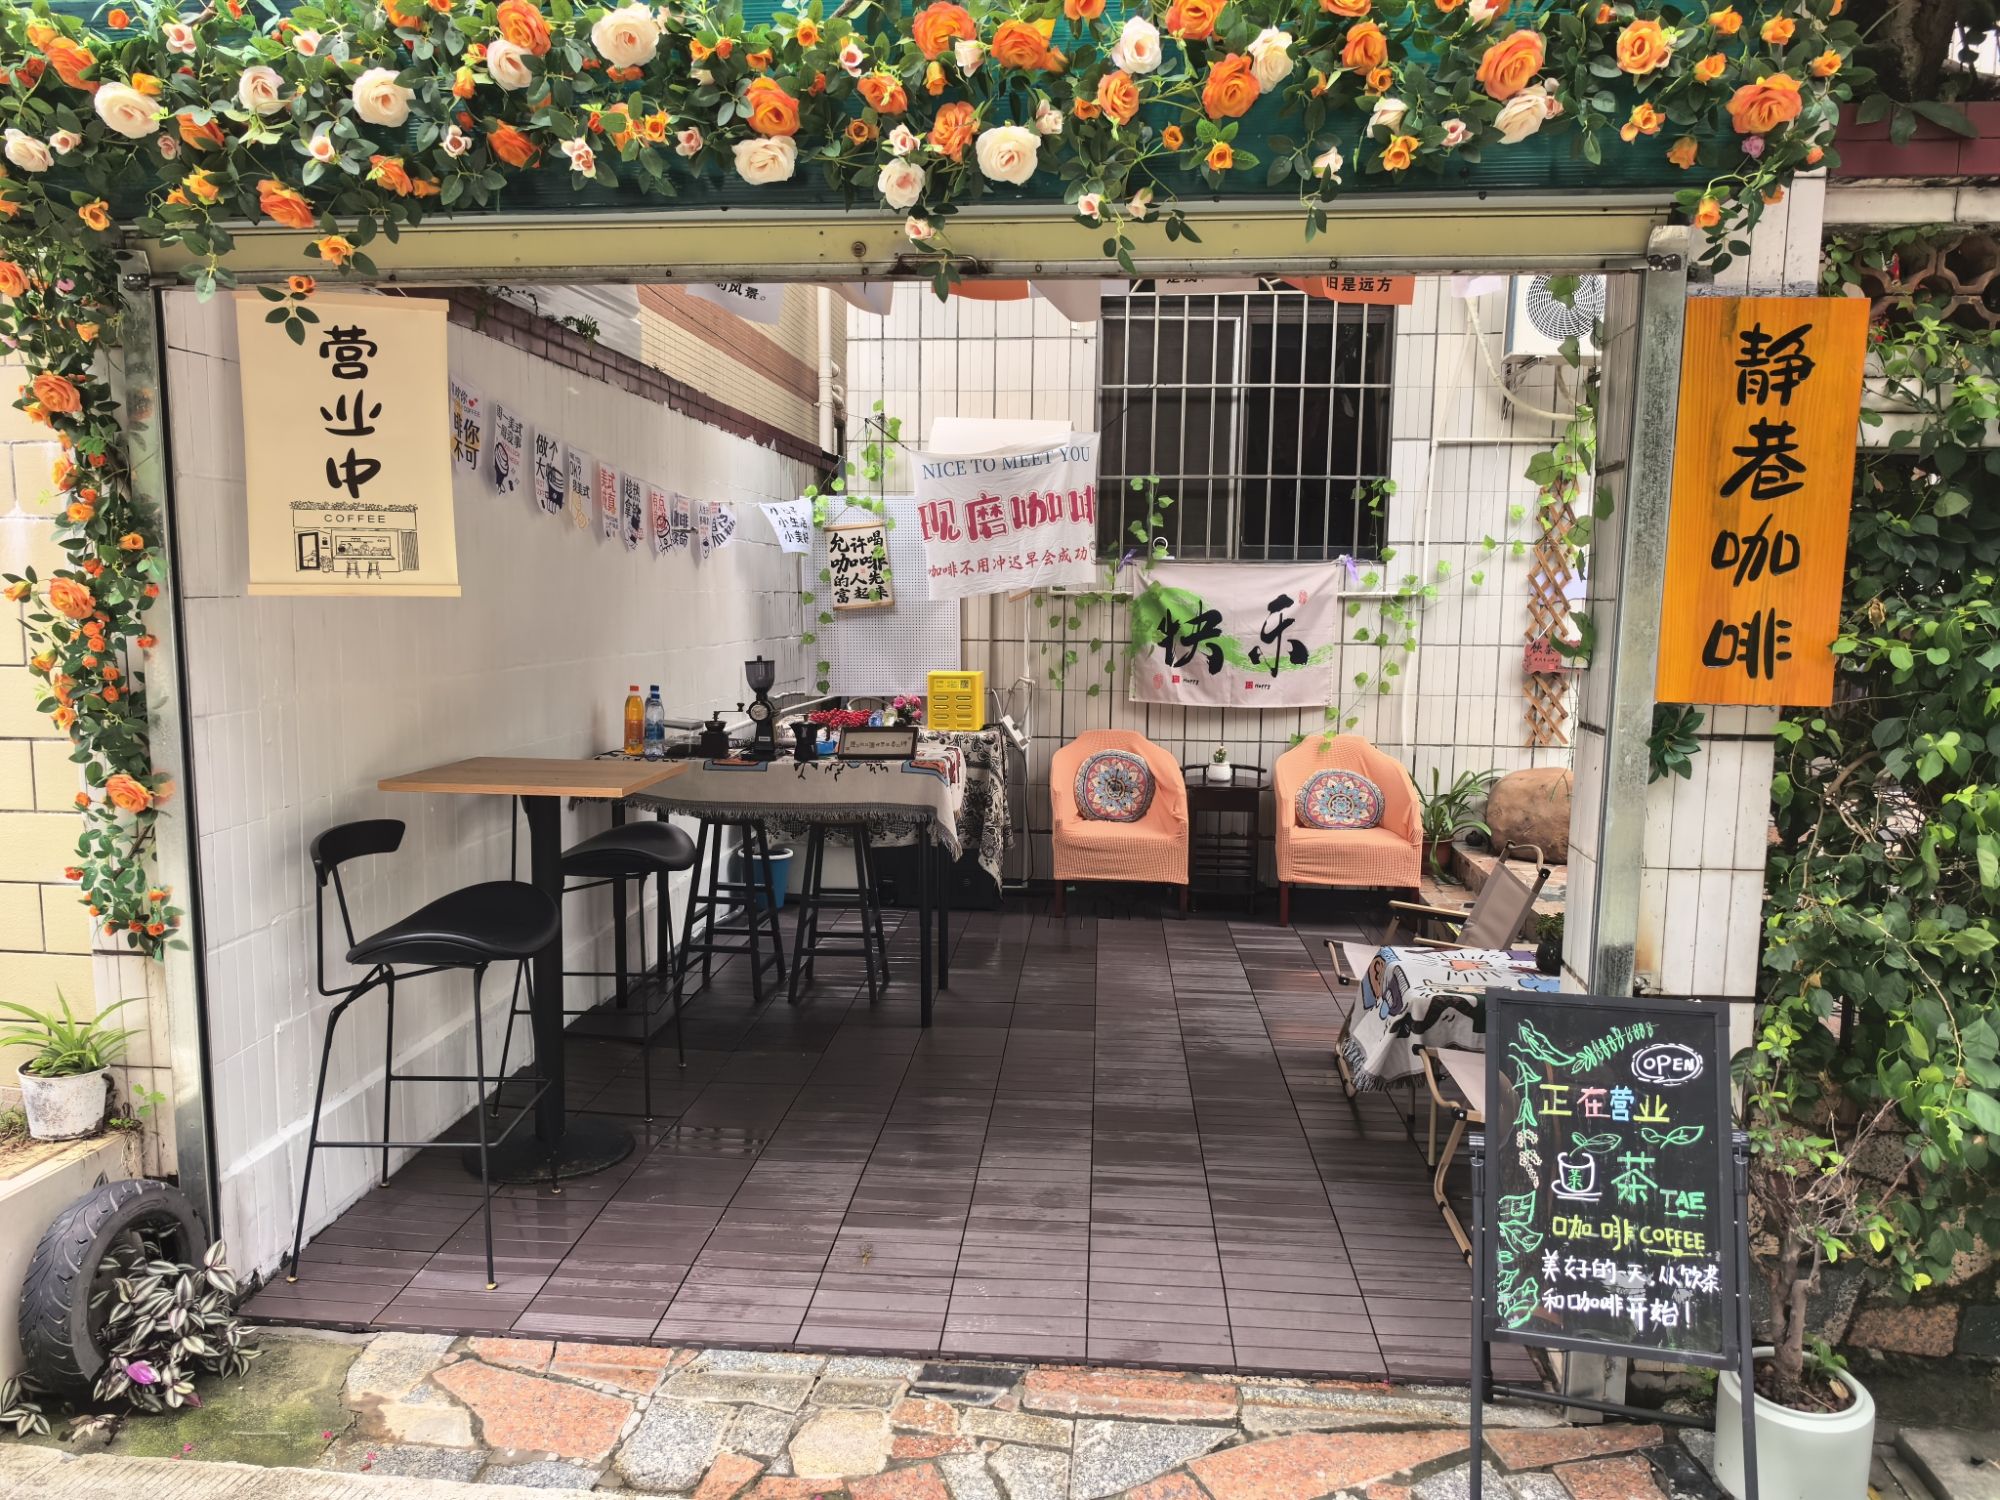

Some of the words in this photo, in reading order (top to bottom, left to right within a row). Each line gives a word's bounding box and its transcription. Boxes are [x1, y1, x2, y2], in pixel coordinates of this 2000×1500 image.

[319, 324, 382, 499] 营业中
[454, 436, 480, 471] 不可
[536, 433, 558, 461] 做个
[922, 460, 967, 480] NICE
[970, 458, 996, 474] TO
[1002, 450, 1055, 471] MEET
[1059, 446, 1091, 462] YOU
[324, 514, 386, 523] COFFEE
[916, 485, 1096, 542] 现磨咖啡
[1702, 322, 1816, 681] 静巷咖啡
[829, 530, 884, 553] 允许喝
[830, 550, 889, 574] 咖啡
[833, 570, 886, 588] 的人先
[928, 546, 1087, 578] 咖啡不用冲迟早会成功
[1157, 593, 1309, 678] 快乐
[1643, 1054, 1696, 1075] OPEN
[1538, 1084, 1670, 1123] 正在营业
[1610, 1151, 1658, 1204] 茶
[1660, 1189, 1707, 1211] TAE
[1552, 1214, 1635, 1251] 咖啡
[1639, 1225, 1706, 1250] COFFEE
